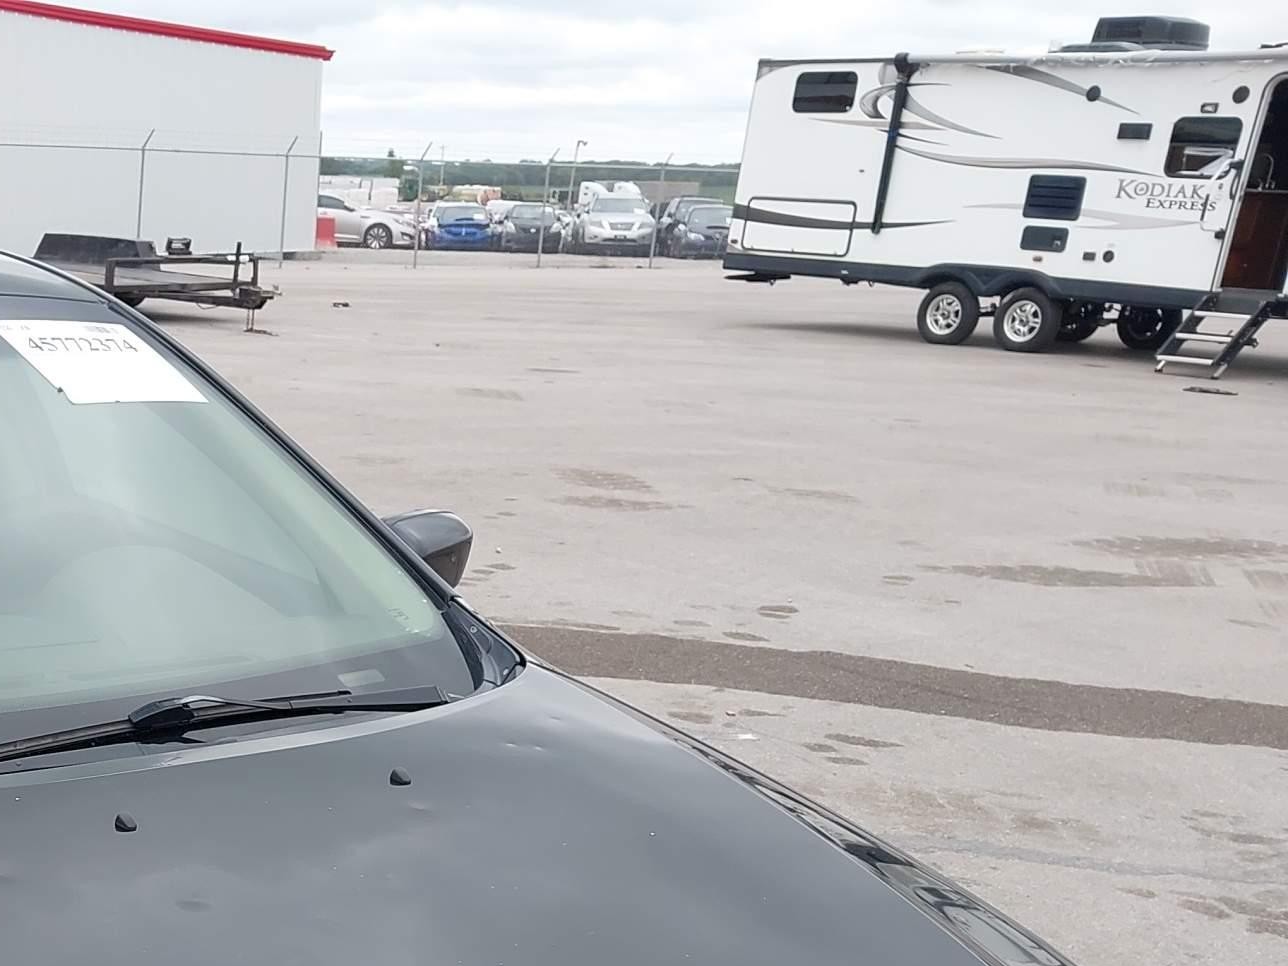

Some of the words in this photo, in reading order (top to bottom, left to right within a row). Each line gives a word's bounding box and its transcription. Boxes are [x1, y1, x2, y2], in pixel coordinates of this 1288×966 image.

[1115, 178, 1205, 200] KODIAK
[1145, 197, 1217, 212] EXPRESS
[27, 337, 139, 353] 45772374
